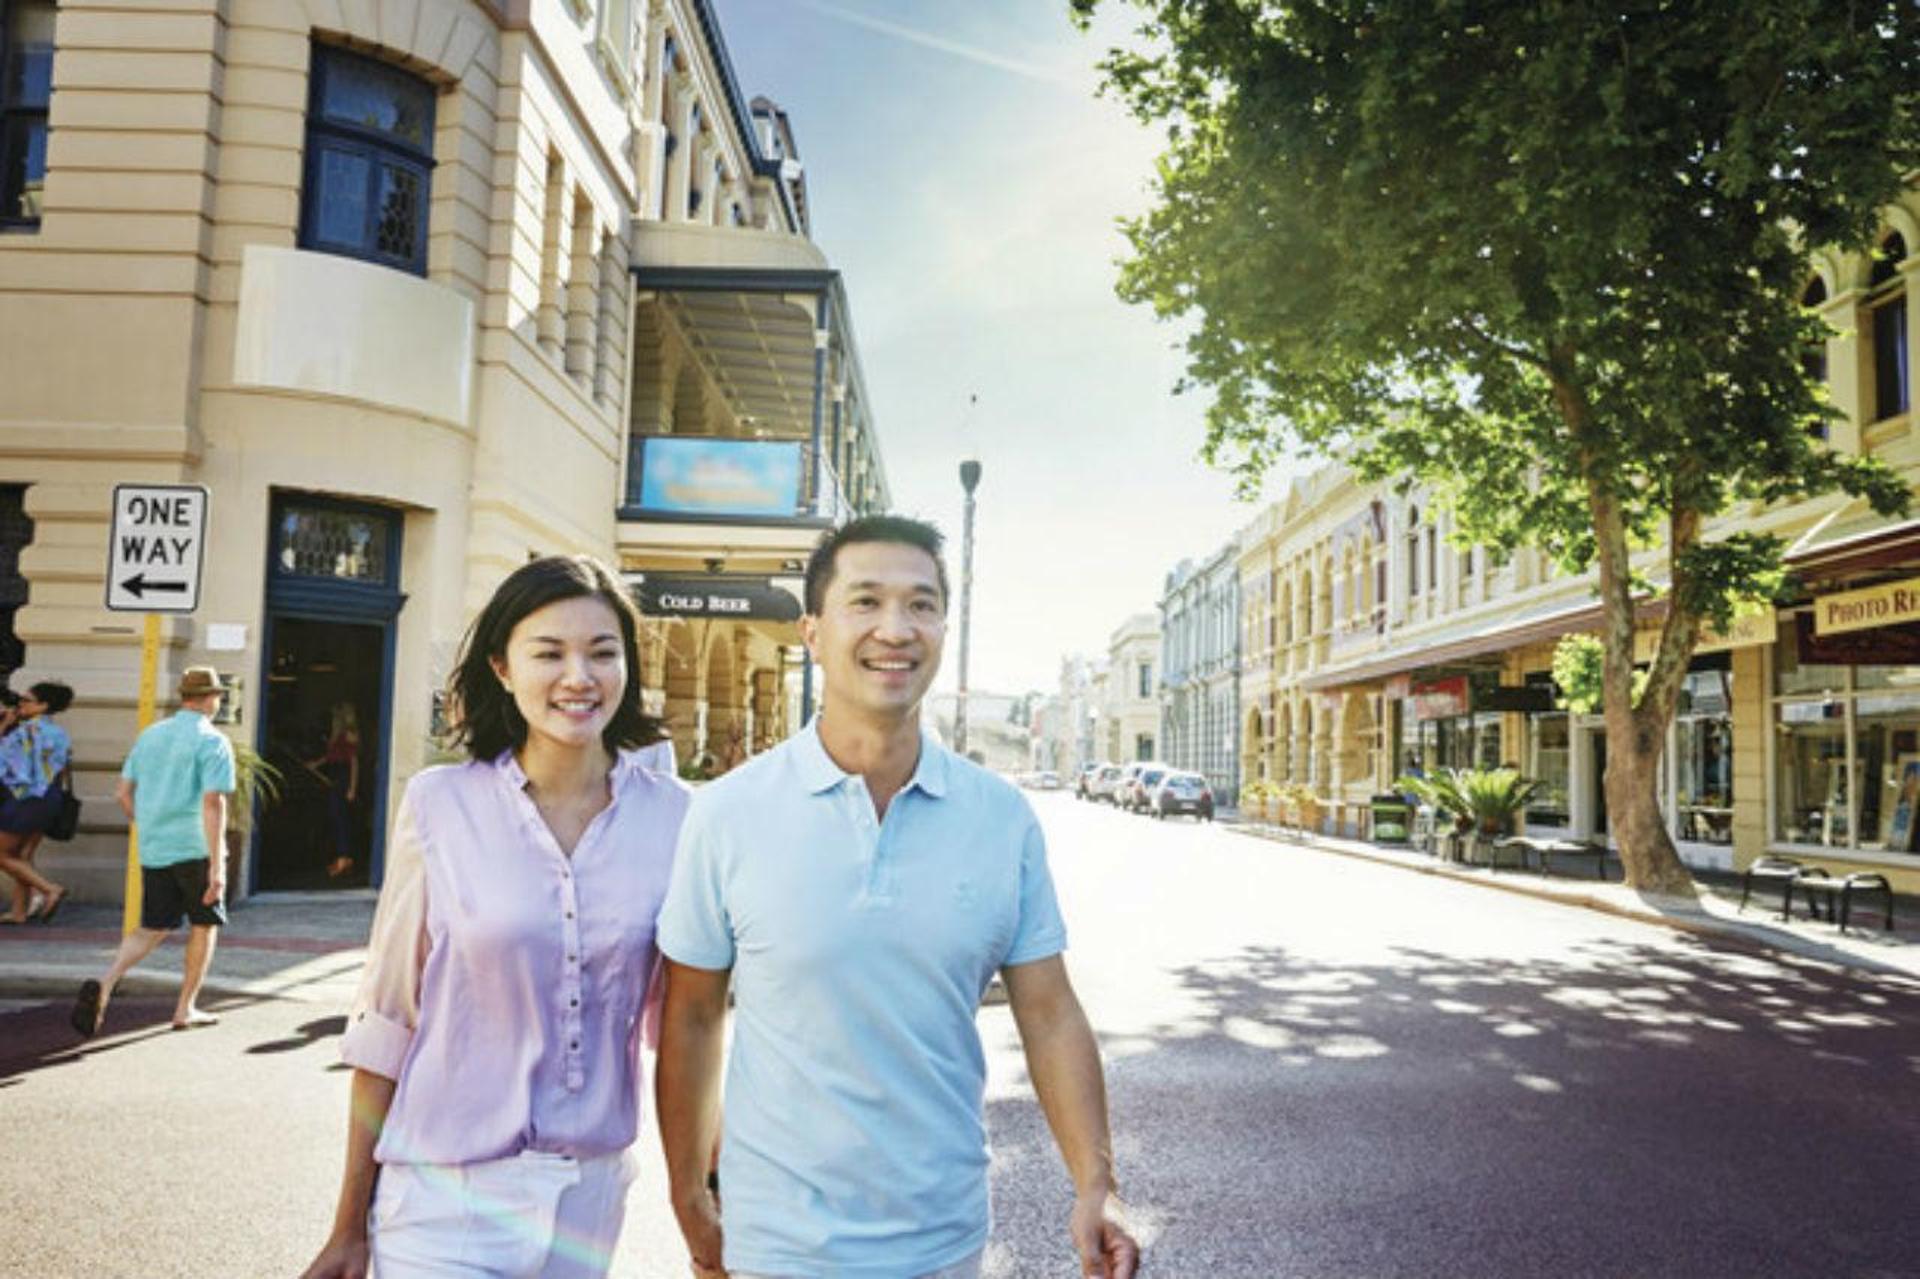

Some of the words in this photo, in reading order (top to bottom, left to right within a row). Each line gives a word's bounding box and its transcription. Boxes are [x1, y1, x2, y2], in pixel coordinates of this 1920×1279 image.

[127, 496, 191, 527] ONE
[121, 534, 192, 565] WAY
[659, 594, 704, 610] COLD
[708, 595, 751, 613] BEER
[1827, 597, 1889, 625] PHOTO
